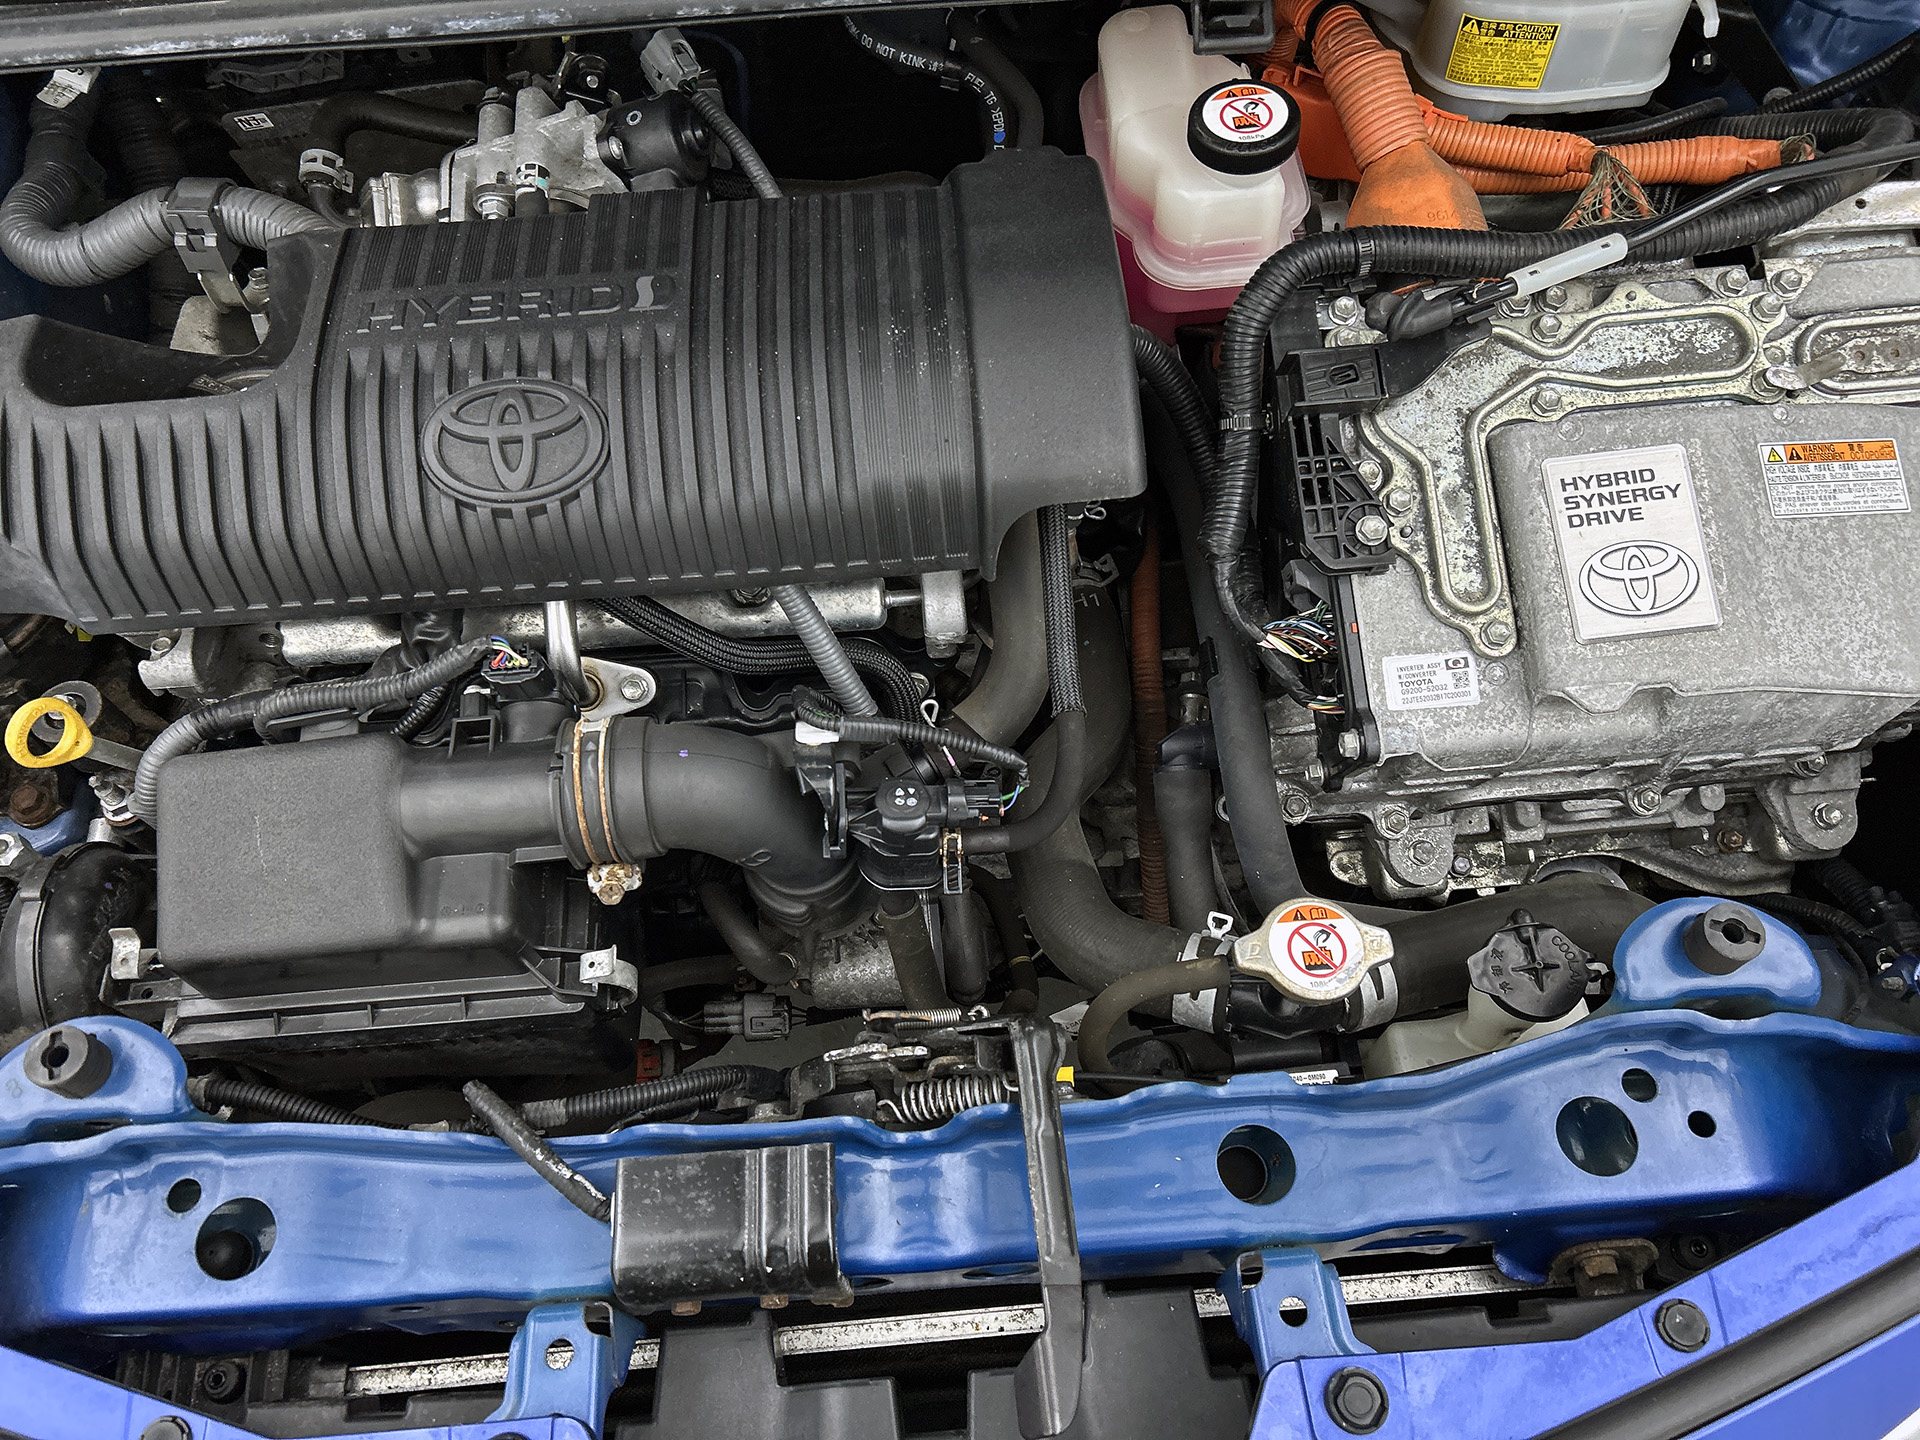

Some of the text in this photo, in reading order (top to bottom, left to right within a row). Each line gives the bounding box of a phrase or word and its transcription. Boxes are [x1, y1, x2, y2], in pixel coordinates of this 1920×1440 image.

[1515, 24, 1555, 33] CAUTION
[1503, 30, 1553, 40] ATTENTION
[875, 42, 896, 59] NOT
[899, 51, 927, 69] KINK
[356, 284, 624, 334] HYBRID
[1801, 443, 1836, 453] WARNING
[1803, 452, 1845, 461] AVERTISSEMENT
[1560, 468, 1656, 492] HYBRID
[1563, 483, 1682, 511] SYNERGY
[1567, 507, 1644, 528] DRIVE
[1396, 663, 1425, 673] INVERTER
[1398, 670, 1437, 680] W/CONVERTER
[1399, 678, 1434, 688] TOYOTA
[1401, 683, 1448, 696] G9200-52032
